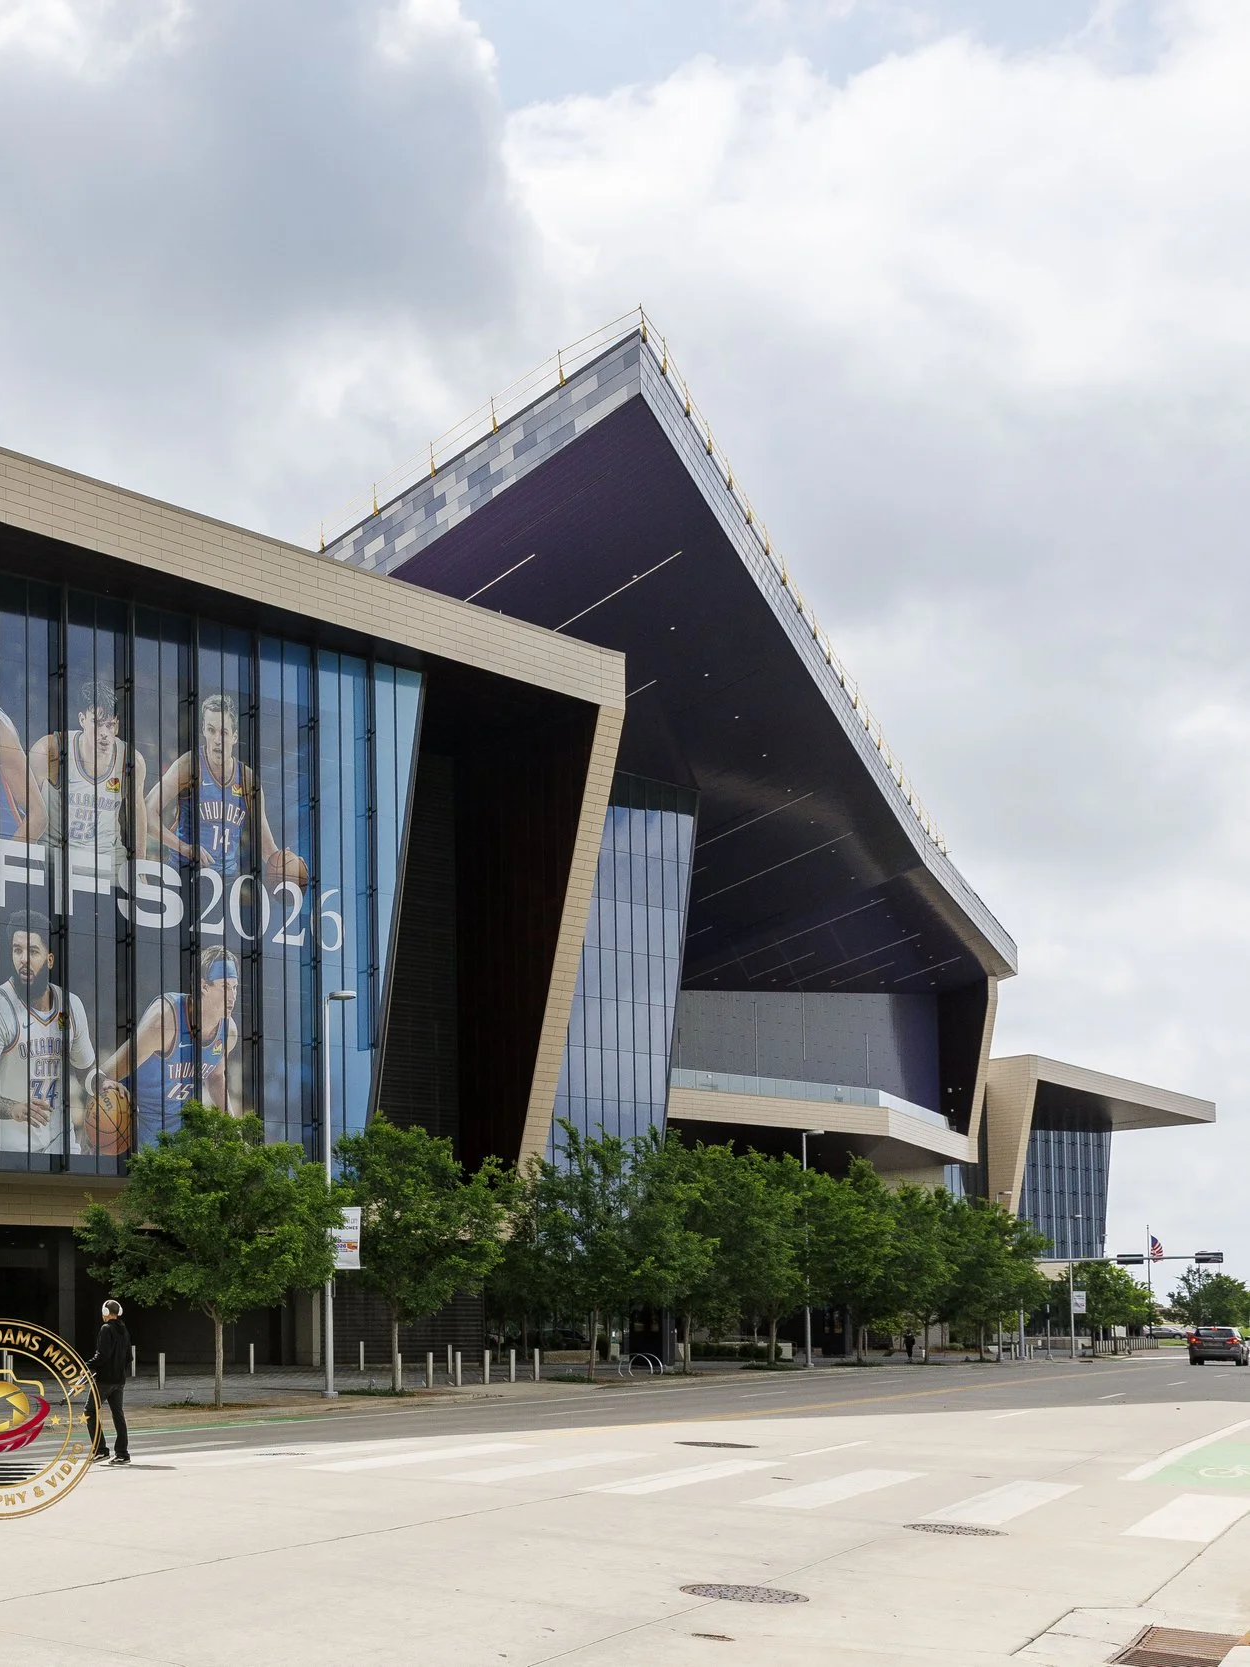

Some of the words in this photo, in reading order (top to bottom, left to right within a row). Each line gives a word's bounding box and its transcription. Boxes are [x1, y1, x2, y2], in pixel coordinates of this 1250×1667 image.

[213, 825, 230, 853] 14
[189, 867, 345, 952] 2026
[167, 1082, 194, 1100] 15
